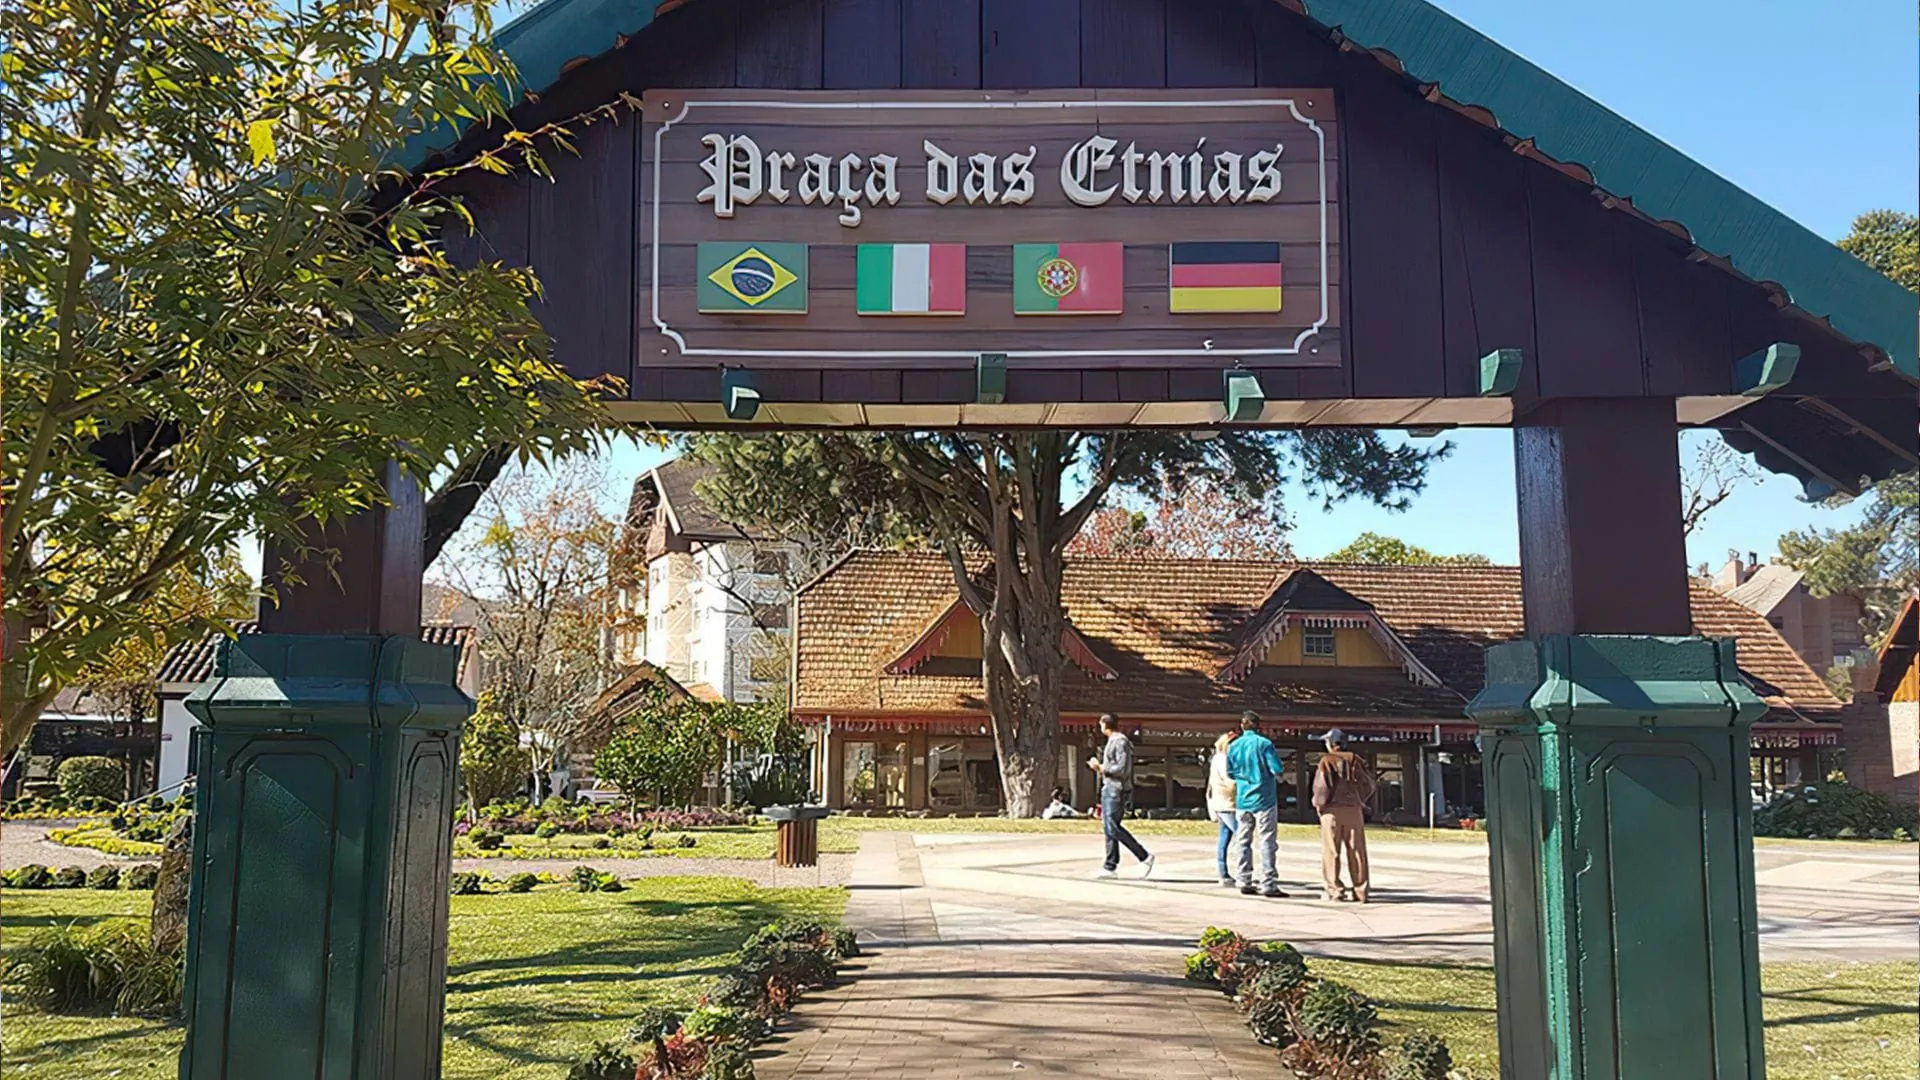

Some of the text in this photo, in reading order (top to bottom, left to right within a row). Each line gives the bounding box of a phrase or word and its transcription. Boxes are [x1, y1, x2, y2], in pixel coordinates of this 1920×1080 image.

[696, 133, 1284, 227] Praça das Etnias
